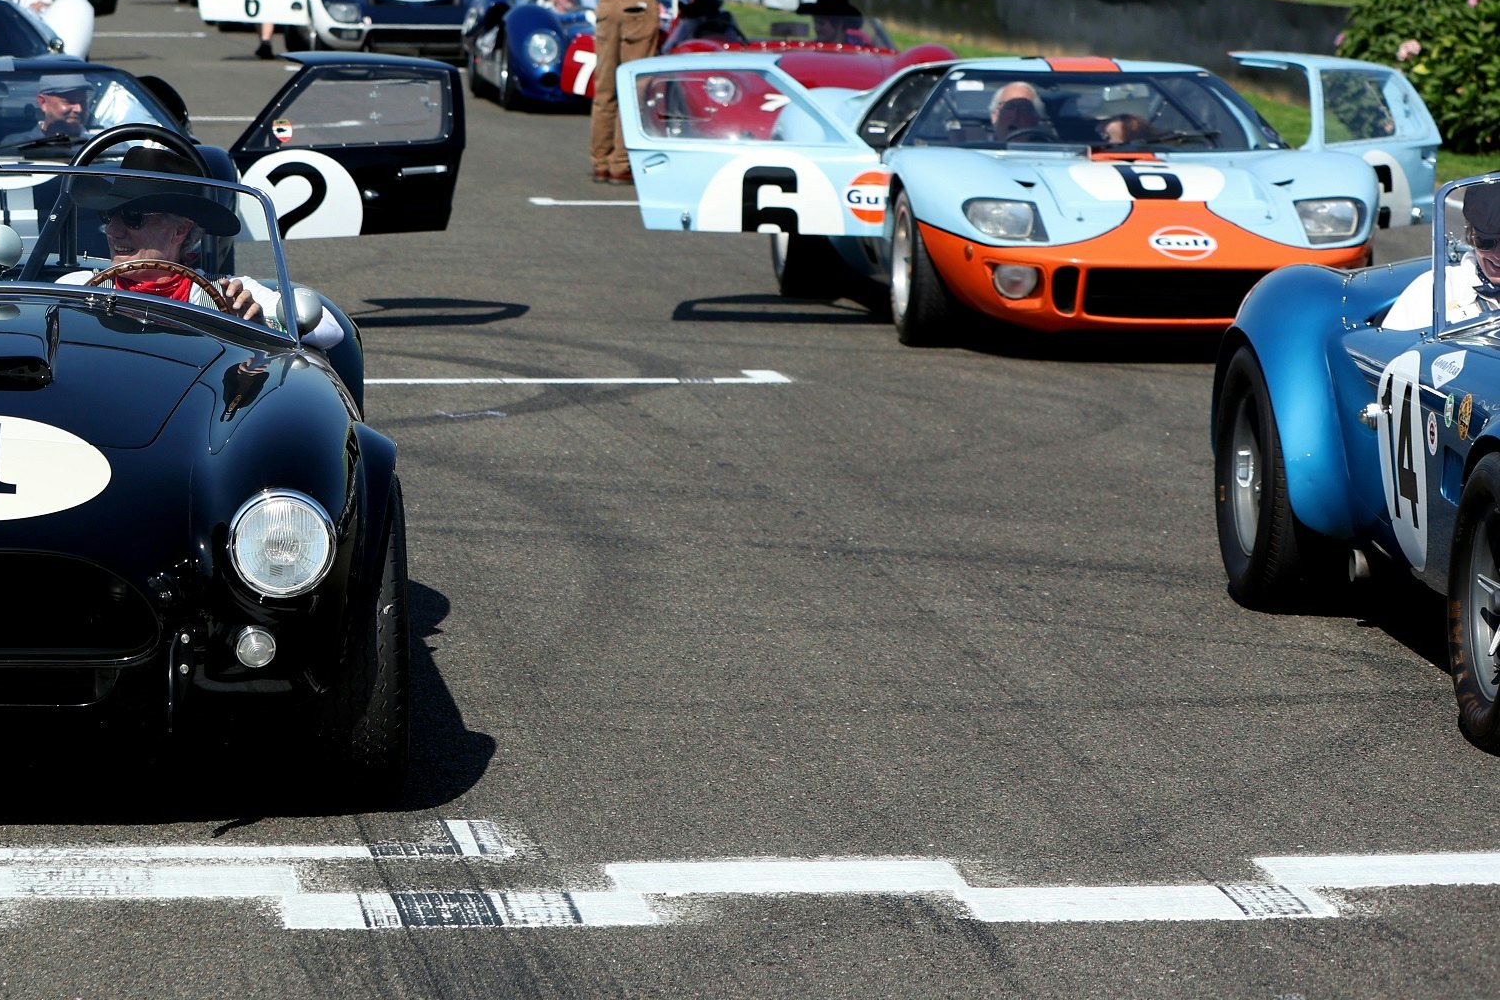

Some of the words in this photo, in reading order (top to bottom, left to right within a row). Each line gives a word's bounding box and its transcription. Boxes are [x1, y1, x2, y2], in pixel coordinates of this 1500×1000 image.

[572, 49, 598, 96] 7
[265, 161, 327, 240] 2
[741, 166, 799, 235] 6
[1113, 164, 1184, 200] 6
[1155, 237, 1211, 247] Gulf
[1382, 373, 1420, 530] 14
